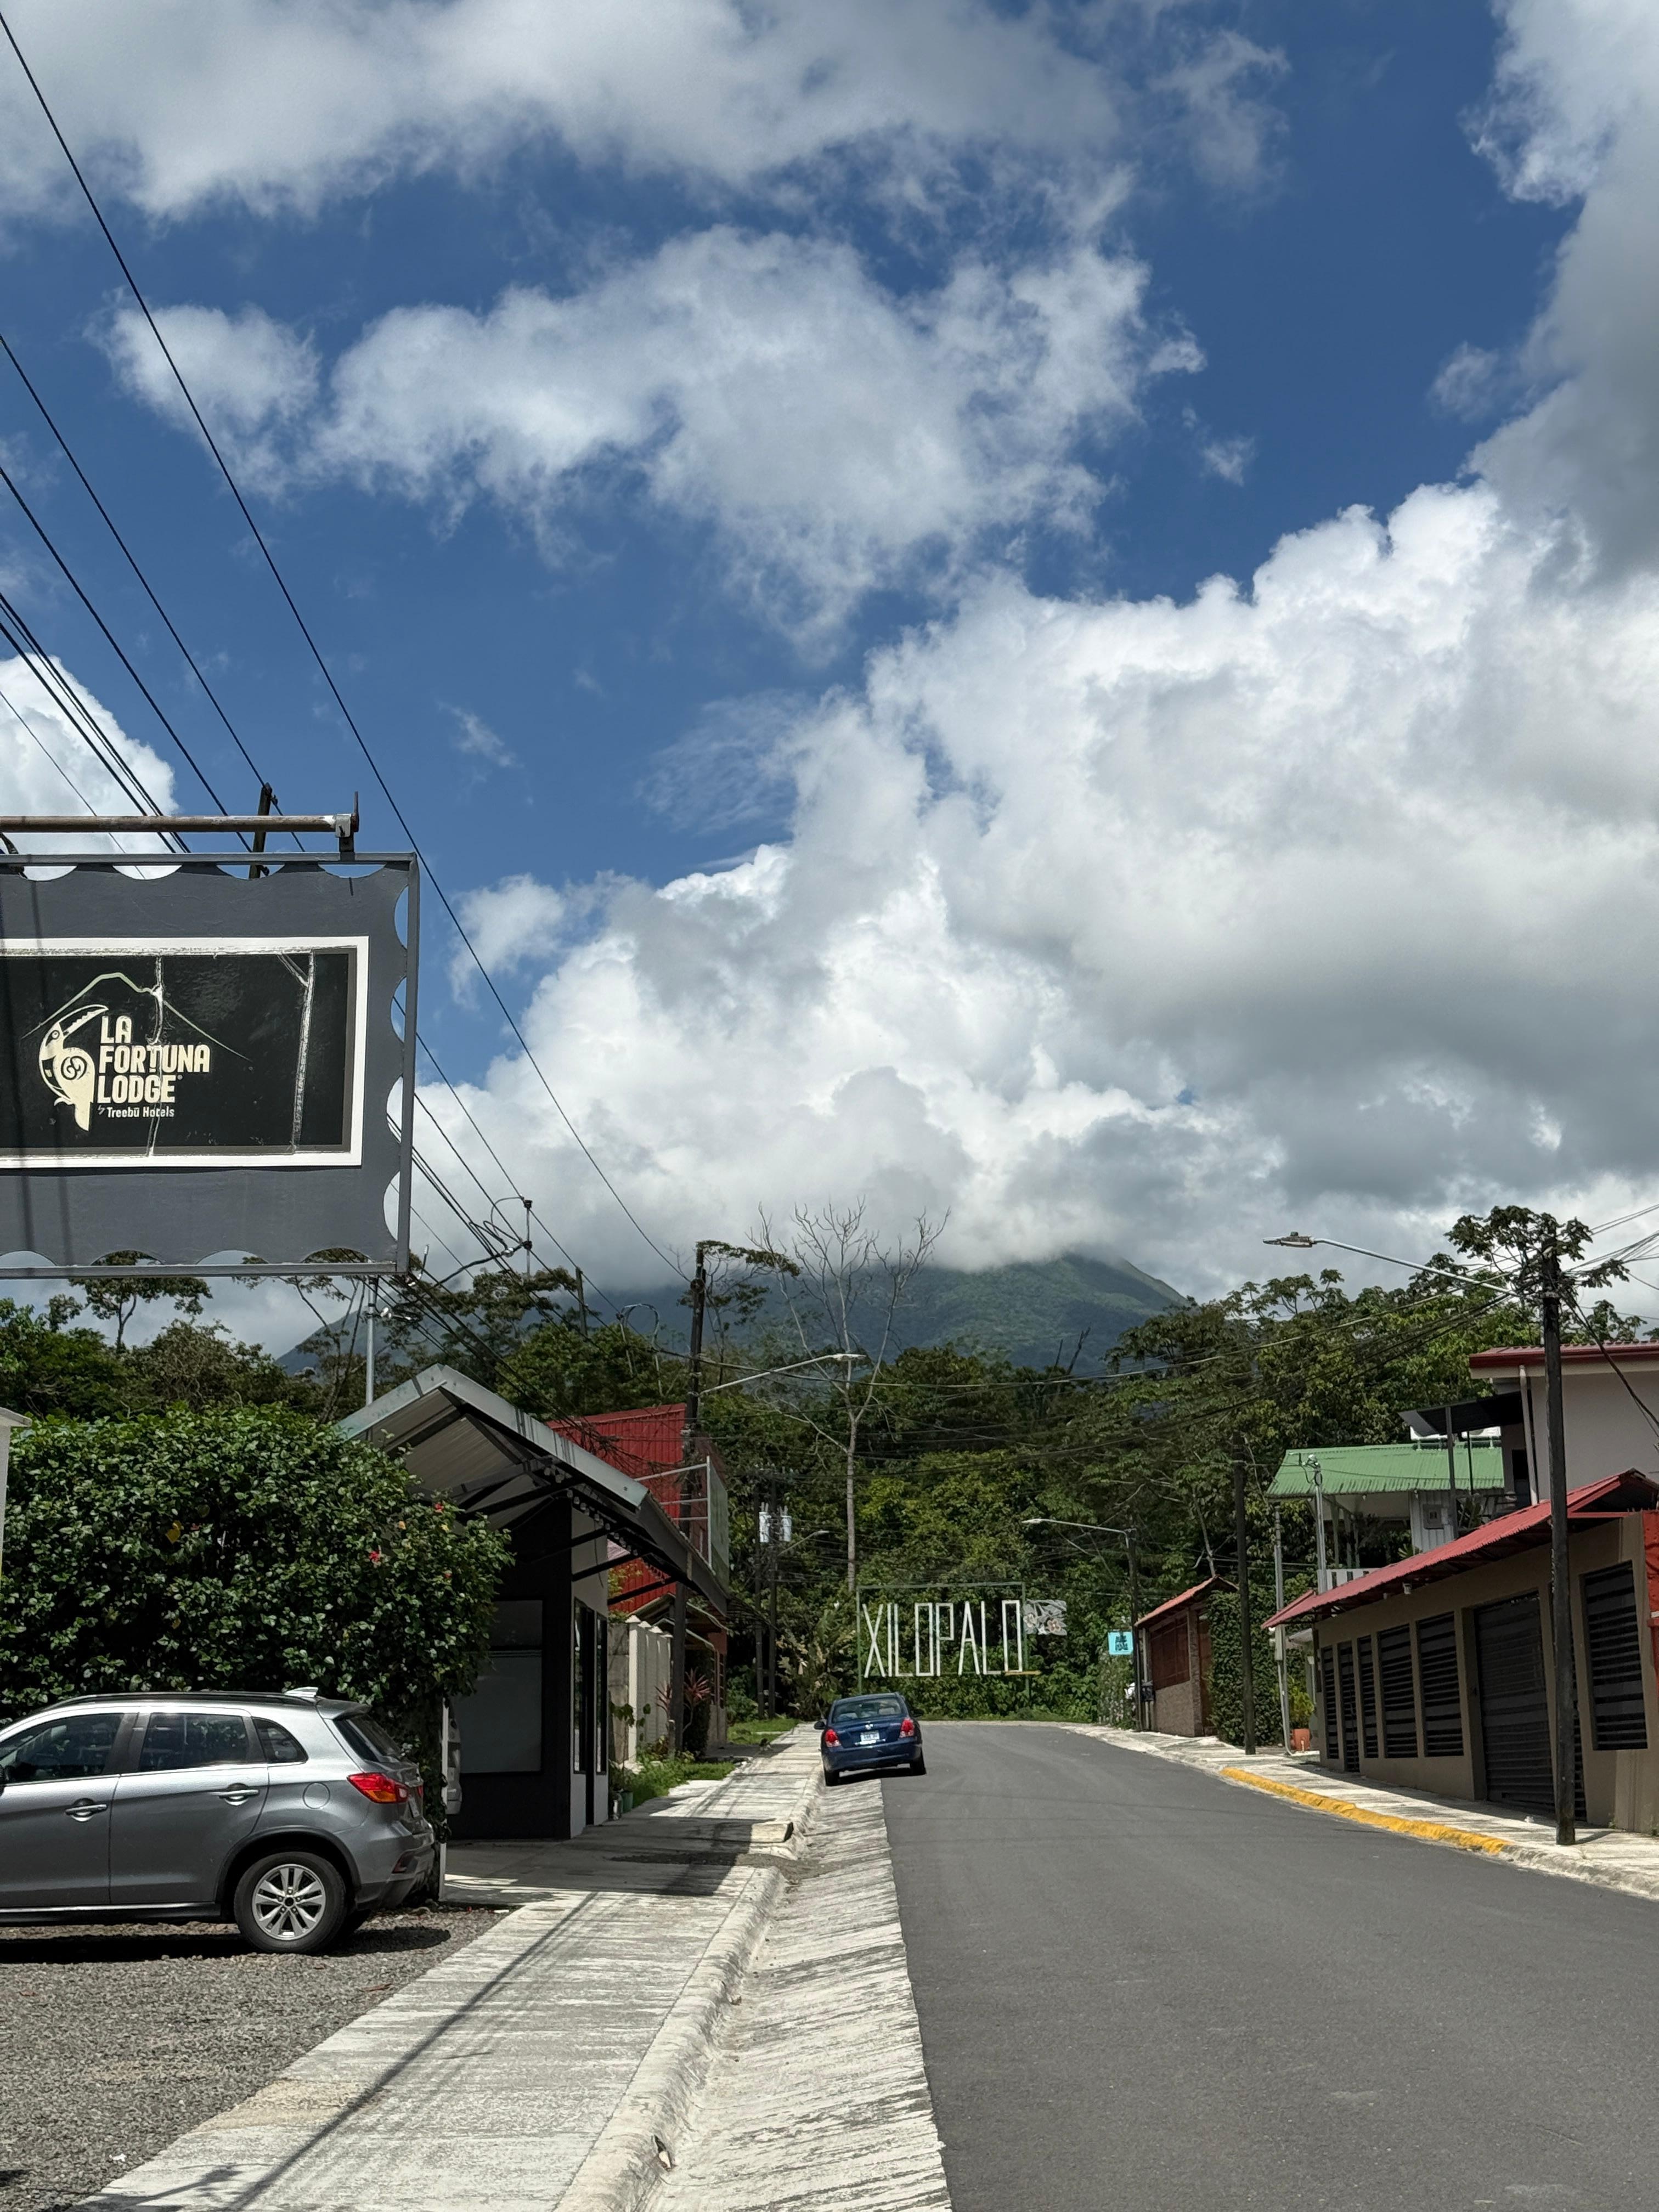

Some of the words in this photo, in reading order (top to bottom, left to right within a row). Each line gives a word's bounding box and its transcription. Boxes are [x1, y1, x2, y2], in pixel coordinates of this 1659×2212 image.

[100, 1015, 132, 1043] LA
[98, 1044, 210, 1073] FORTUNA
[97, 1075, 176, 1103] LODGE
[142, 1105, 174, 1118] Hotels
[862, 1599, 1023, 1678] XILOPALO
